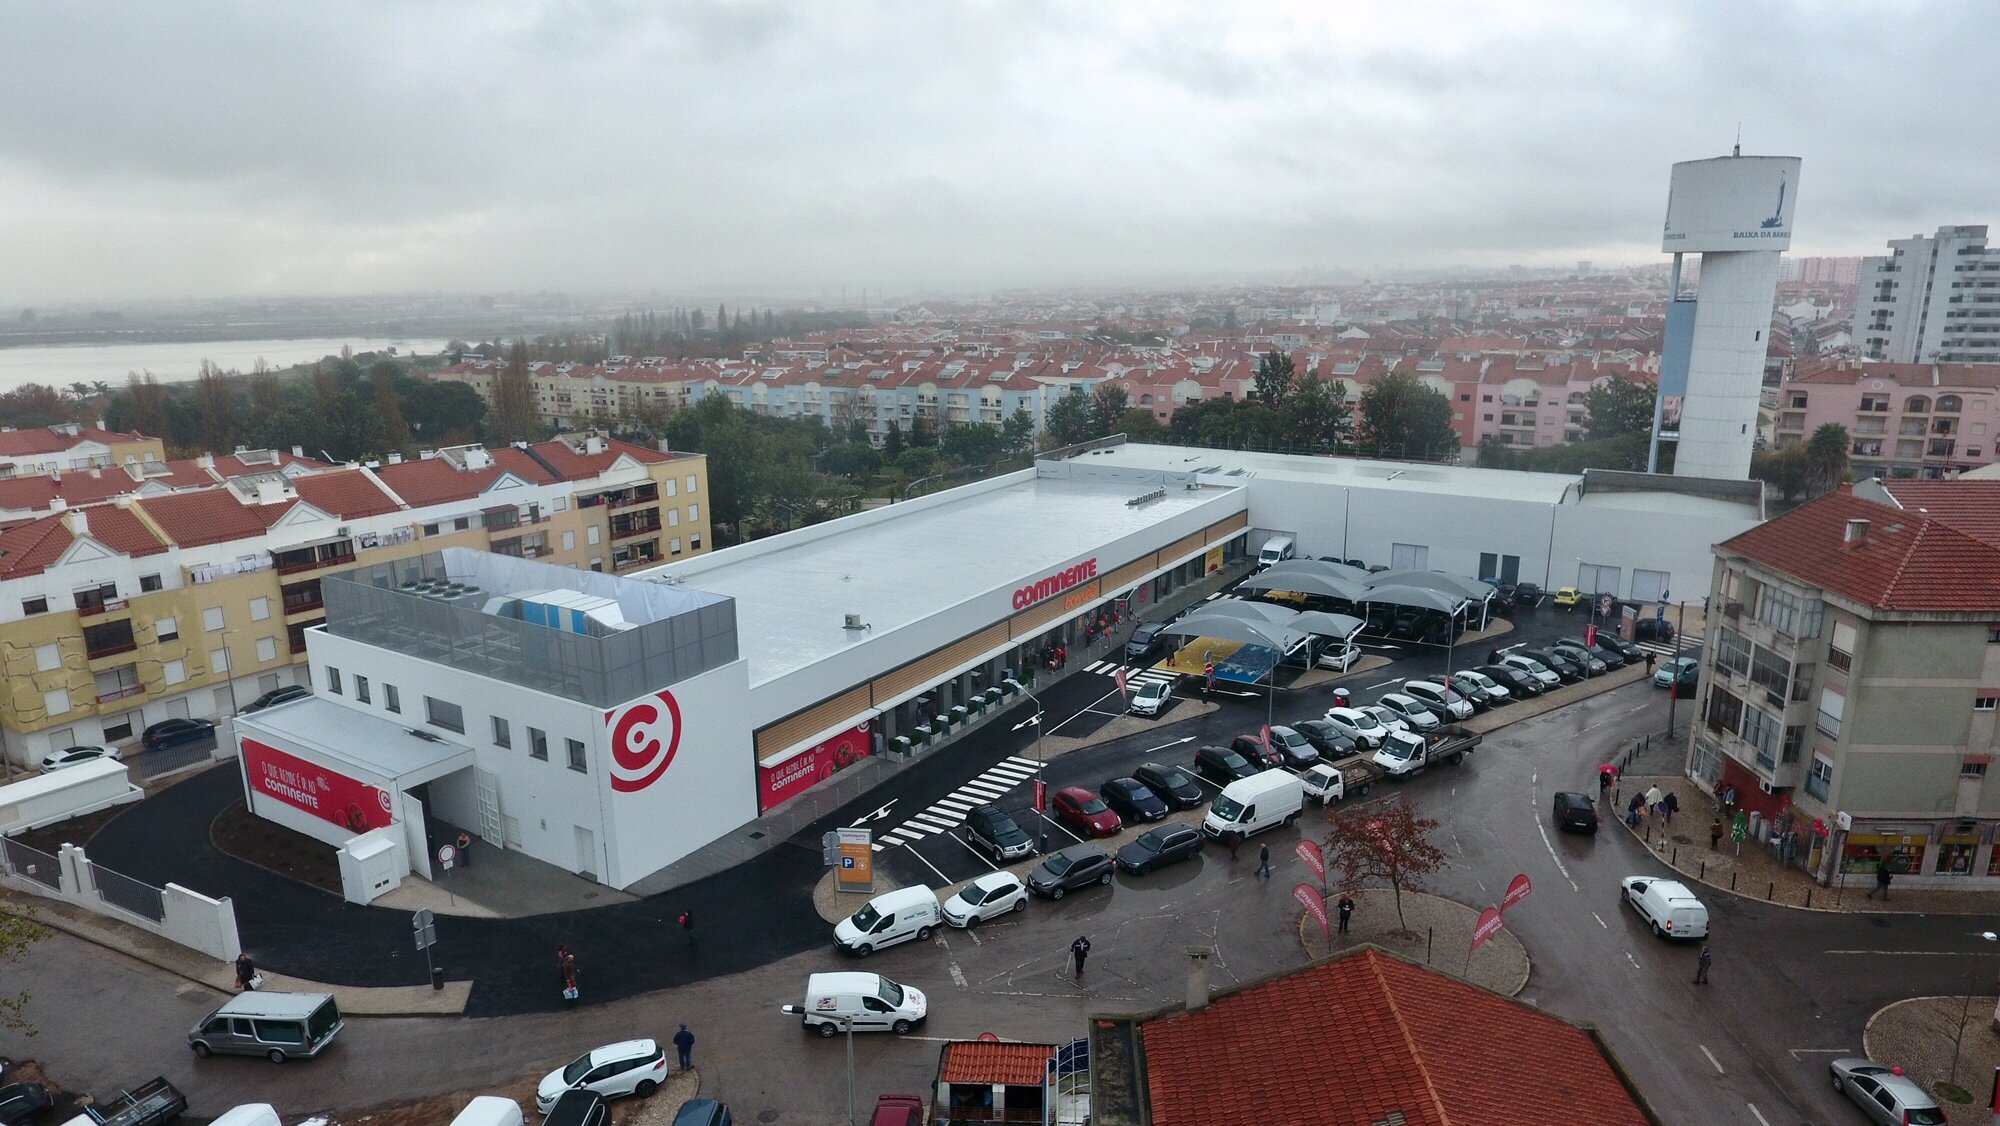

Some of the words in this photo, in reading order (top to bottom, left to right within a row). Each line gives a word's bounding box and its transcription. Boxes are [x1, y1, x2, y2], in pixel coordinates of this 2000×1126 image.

[1733, 231, 1758, 239] BAIXA
[1760, 231, 1772, 239] DA
[1012, 557, 1097, 610] CONTINENTE
[261, 761, 267, 775] O
[267, 763, 279, 780] QUE
[771, 763, 815, 791] CONTINENTE
[776, 768, 785, 780] QUE
[264, 777, 319, 809] CONTINENTE
[844, 858, 852, 867] P
